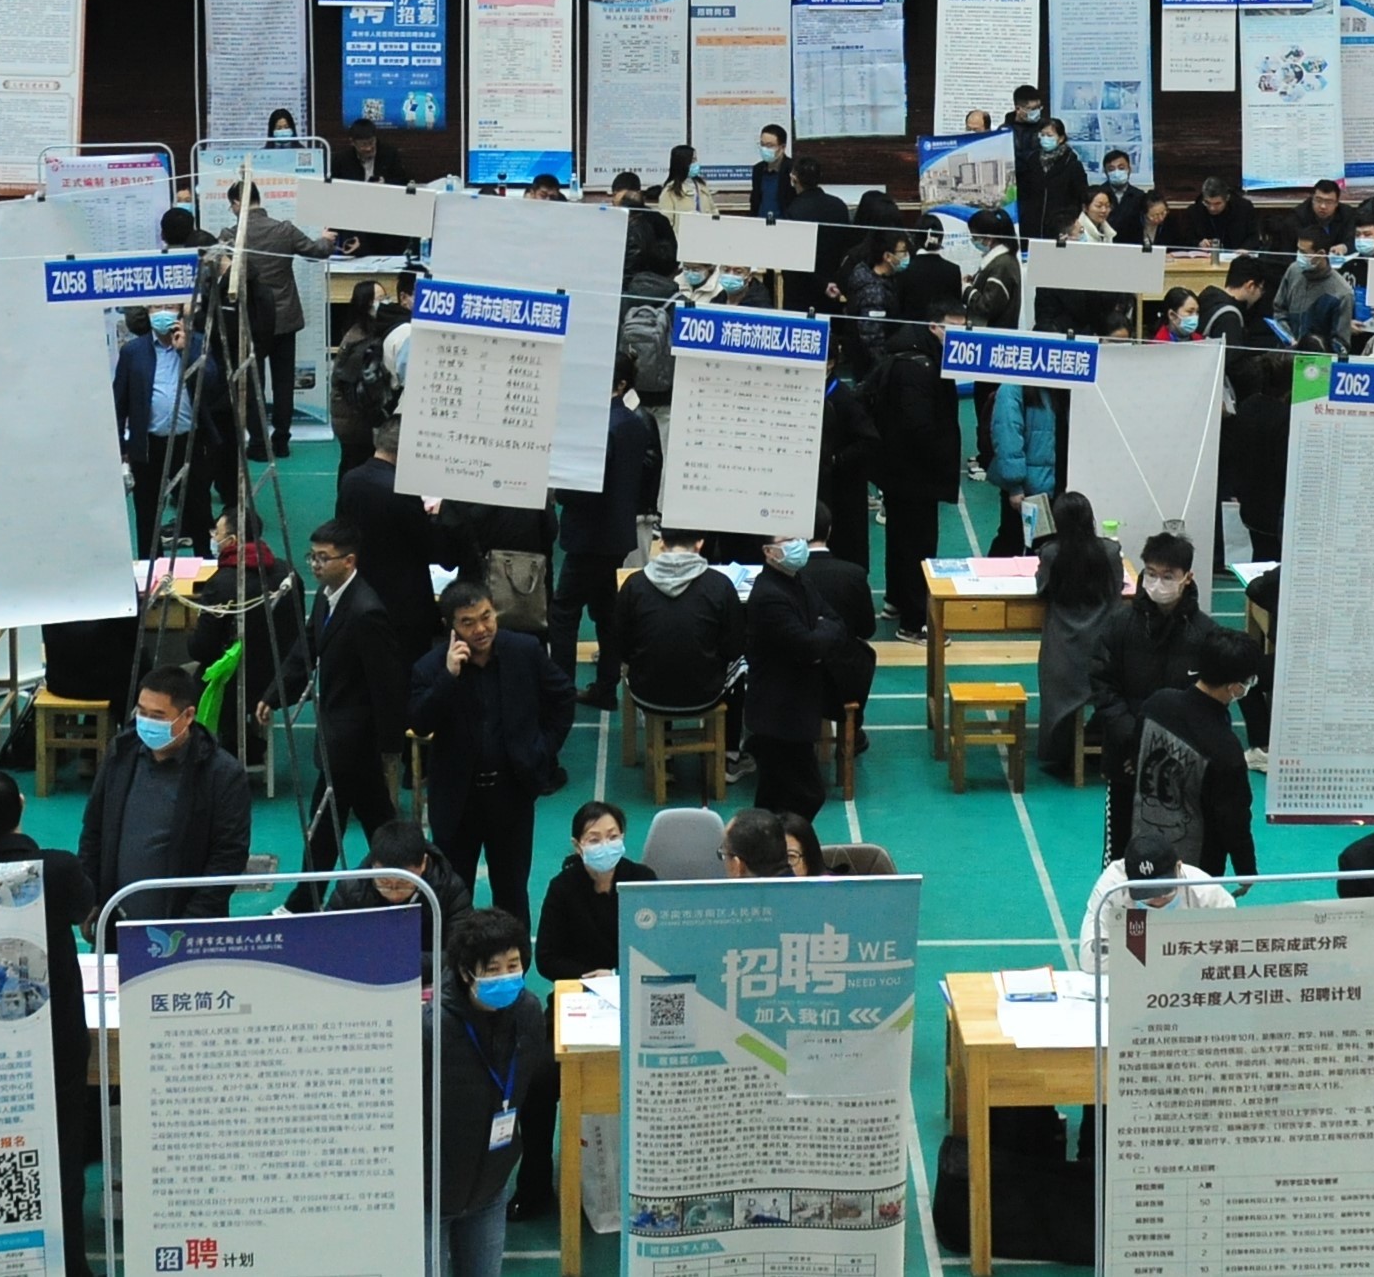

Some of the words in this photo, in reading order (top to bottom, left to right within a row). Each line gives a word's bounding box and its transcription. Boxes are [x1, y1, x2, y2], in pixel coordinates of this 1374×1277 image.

[397, 6, 436, 24] 招募
[697, 7, 731, 16] 招聘岗位
[62, 178, 104, 188] 正式编制
[52, 268, 87, 294] Z058
[93, 264, 196, 293] 聊城市茌平区人民医院
[420, 288, 456, 317] Z059
[460, 292, 562, 329] 菏泽市定陶区人民医院
[680, 316, 715, 344] Z060
[720, 321, 821, 356] 济南市济阳区人民医院
[947, 340, 982, 366] Z061
[989, 343, 1091, 376] 成武县人民医院
[1335, 372, 1371, 397] Z062
[659, 906, 773, 920] 济南市济阳区人民医院
[186, 933, 284, 947] 菏泽市定陶区人民医院
[858, 940, 897, 961] WE
[1162, 935, 1348, 956] 山东大学第二医院成武分院
[721, 922, 914, 1019] 招聘
[1201, 962, 1309, 981] 成武县人民医院
[848, 978, 876, 988] NEED
[879, 976, 901, 986] YOU
[151, 990, 235, 1013] 医院简介
[1146, 985, 1362, 1009] 2023年度人才引进、招聘计划
[755, 1007, 840, 1025] 加入我们
[1199, 1198, 1211, 1207] 50
[156, 1238, 255, 1272] 招聘计划
